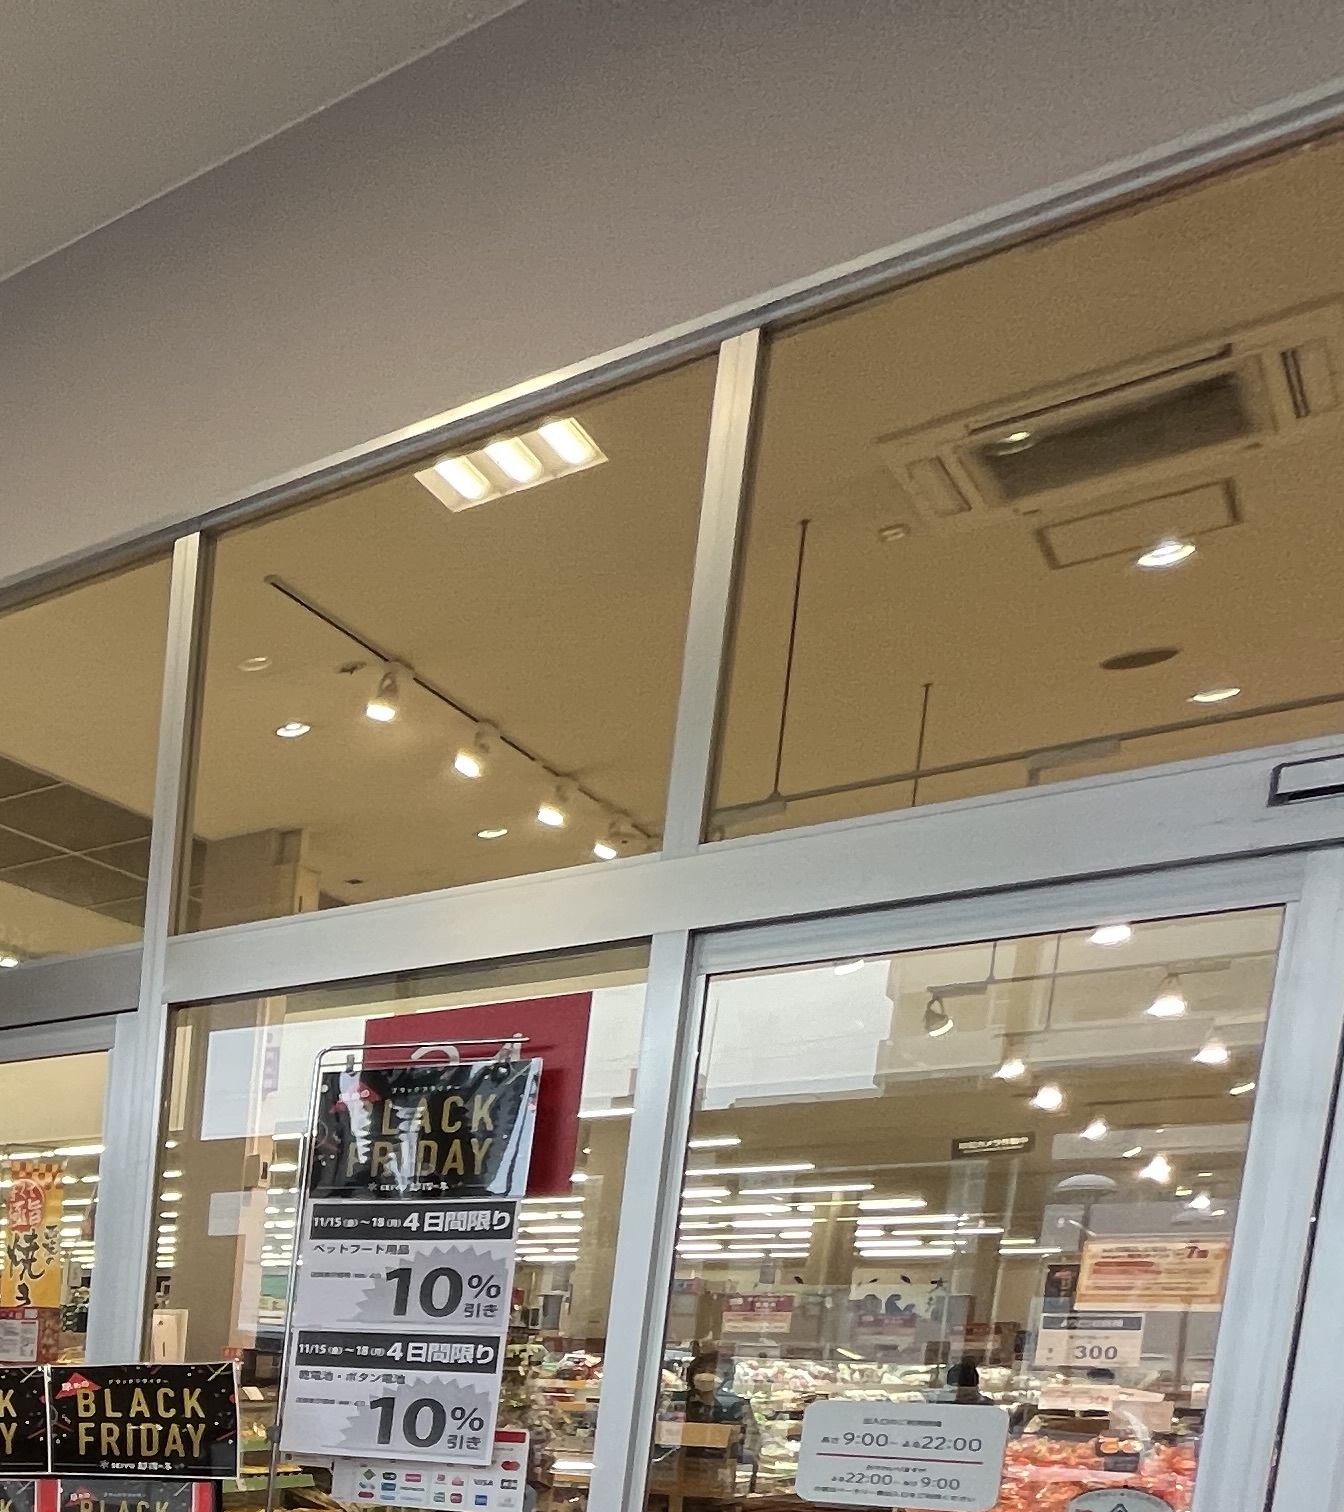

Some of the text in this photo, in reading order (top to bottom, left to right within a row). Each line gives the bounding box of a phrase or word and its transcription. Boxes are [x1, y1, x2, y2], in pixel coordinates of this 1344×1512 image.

[358, 1094, 496, 1136] LACK
[346, 1138, 493, 1178] FRDAY
[386, 1267, 501, 1317] 10 %
[463, 1302, 499, 1318] 引き
[1075, 1345, 1118, 1360] 300
[76, 1387, 206, 1418] BLACK
[78, 1422, 206, 1458] FRIDAY
[370, 1397, 484, 1448] 10 %
[447, 1435, 482, 1450] 引き
